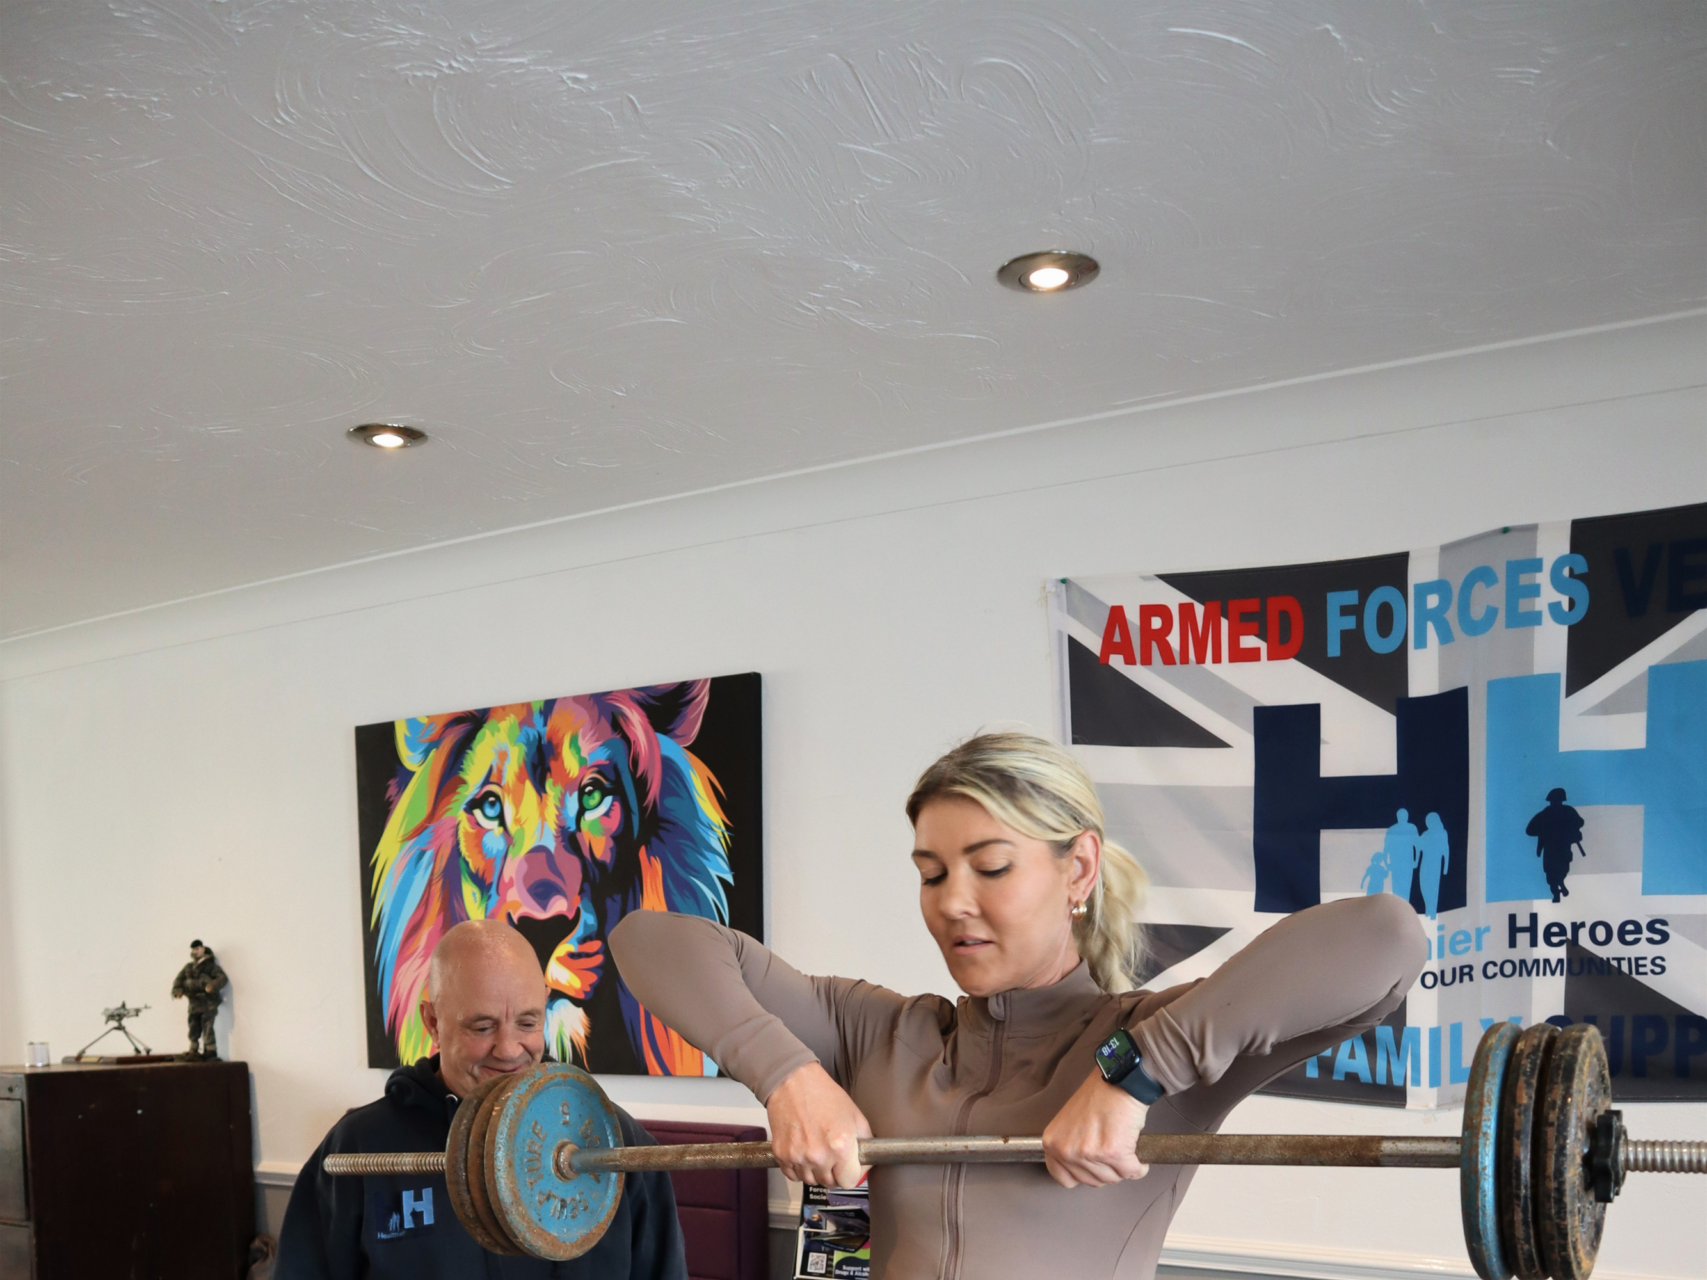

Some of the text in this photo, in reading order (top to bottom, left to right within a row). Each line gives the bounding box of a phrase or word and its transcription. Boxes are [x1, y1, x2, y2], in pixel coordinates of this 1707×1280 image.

[1100, 595, 1305, 666] ARMED
[1326, 553, 1590, 658] FORCES
[1508, 912, 1671, 949] Heroes
[1421, 955, 1667, 990] OUR COMMUNITIES
[1101, 1037, 1120, 1056] 13:18
[1546, 1014, 1707, 1079] UPP
